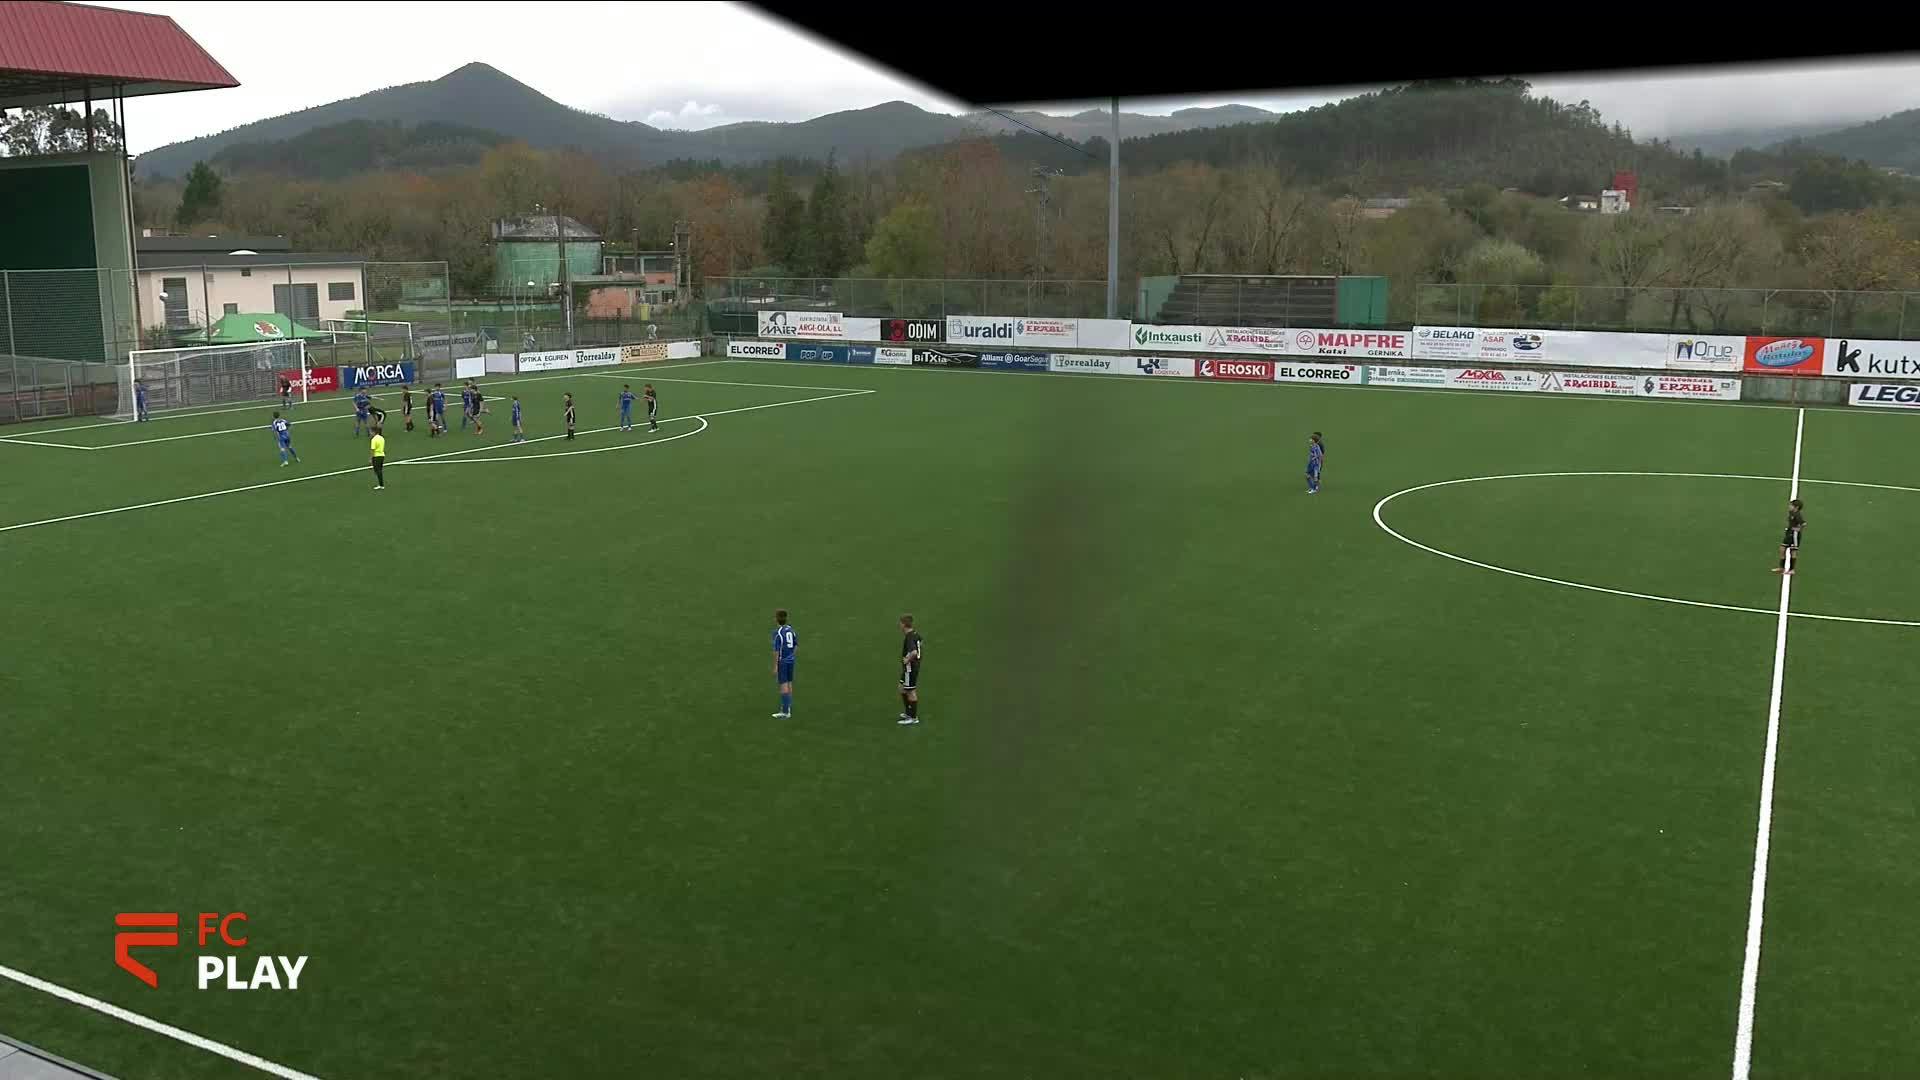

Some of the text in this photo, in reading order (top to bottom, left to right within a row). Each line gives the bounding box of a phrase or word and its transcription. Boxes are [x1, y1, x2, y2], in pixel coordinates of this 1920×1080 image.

[908, 323, 937, 339] ODIM
[1148, 331, 1202, 342] Intxausti
[1432, 330, 1475, 340] BELAKO
[1318, 333, 1405, 348] MAPFRE
[731, 345, 780, 356] EL CORREO
[800, 349, 833, 360] POP UP
[1368, 349, 1404, 357] GERNIKA
[1694, 340, 1733, 357] Orue
[520, 354, 569, 364] OPTIKA EGUREN
[576, 350, 616, 363] Torrealday
[981, 353, 1003, 362] Allianz
[1055, 355, 1111, 369] Torrealday
[354, 363, 405, 384] MORGA
[1219, 363, 1266, 376] EROSKI
[1280, 367, 1350, 380] EL CORREO
[304, 376, 332, 387] POPULAR
[1858, 386, 1920, 403] LEG
[785, 631, 794, 648] 9
